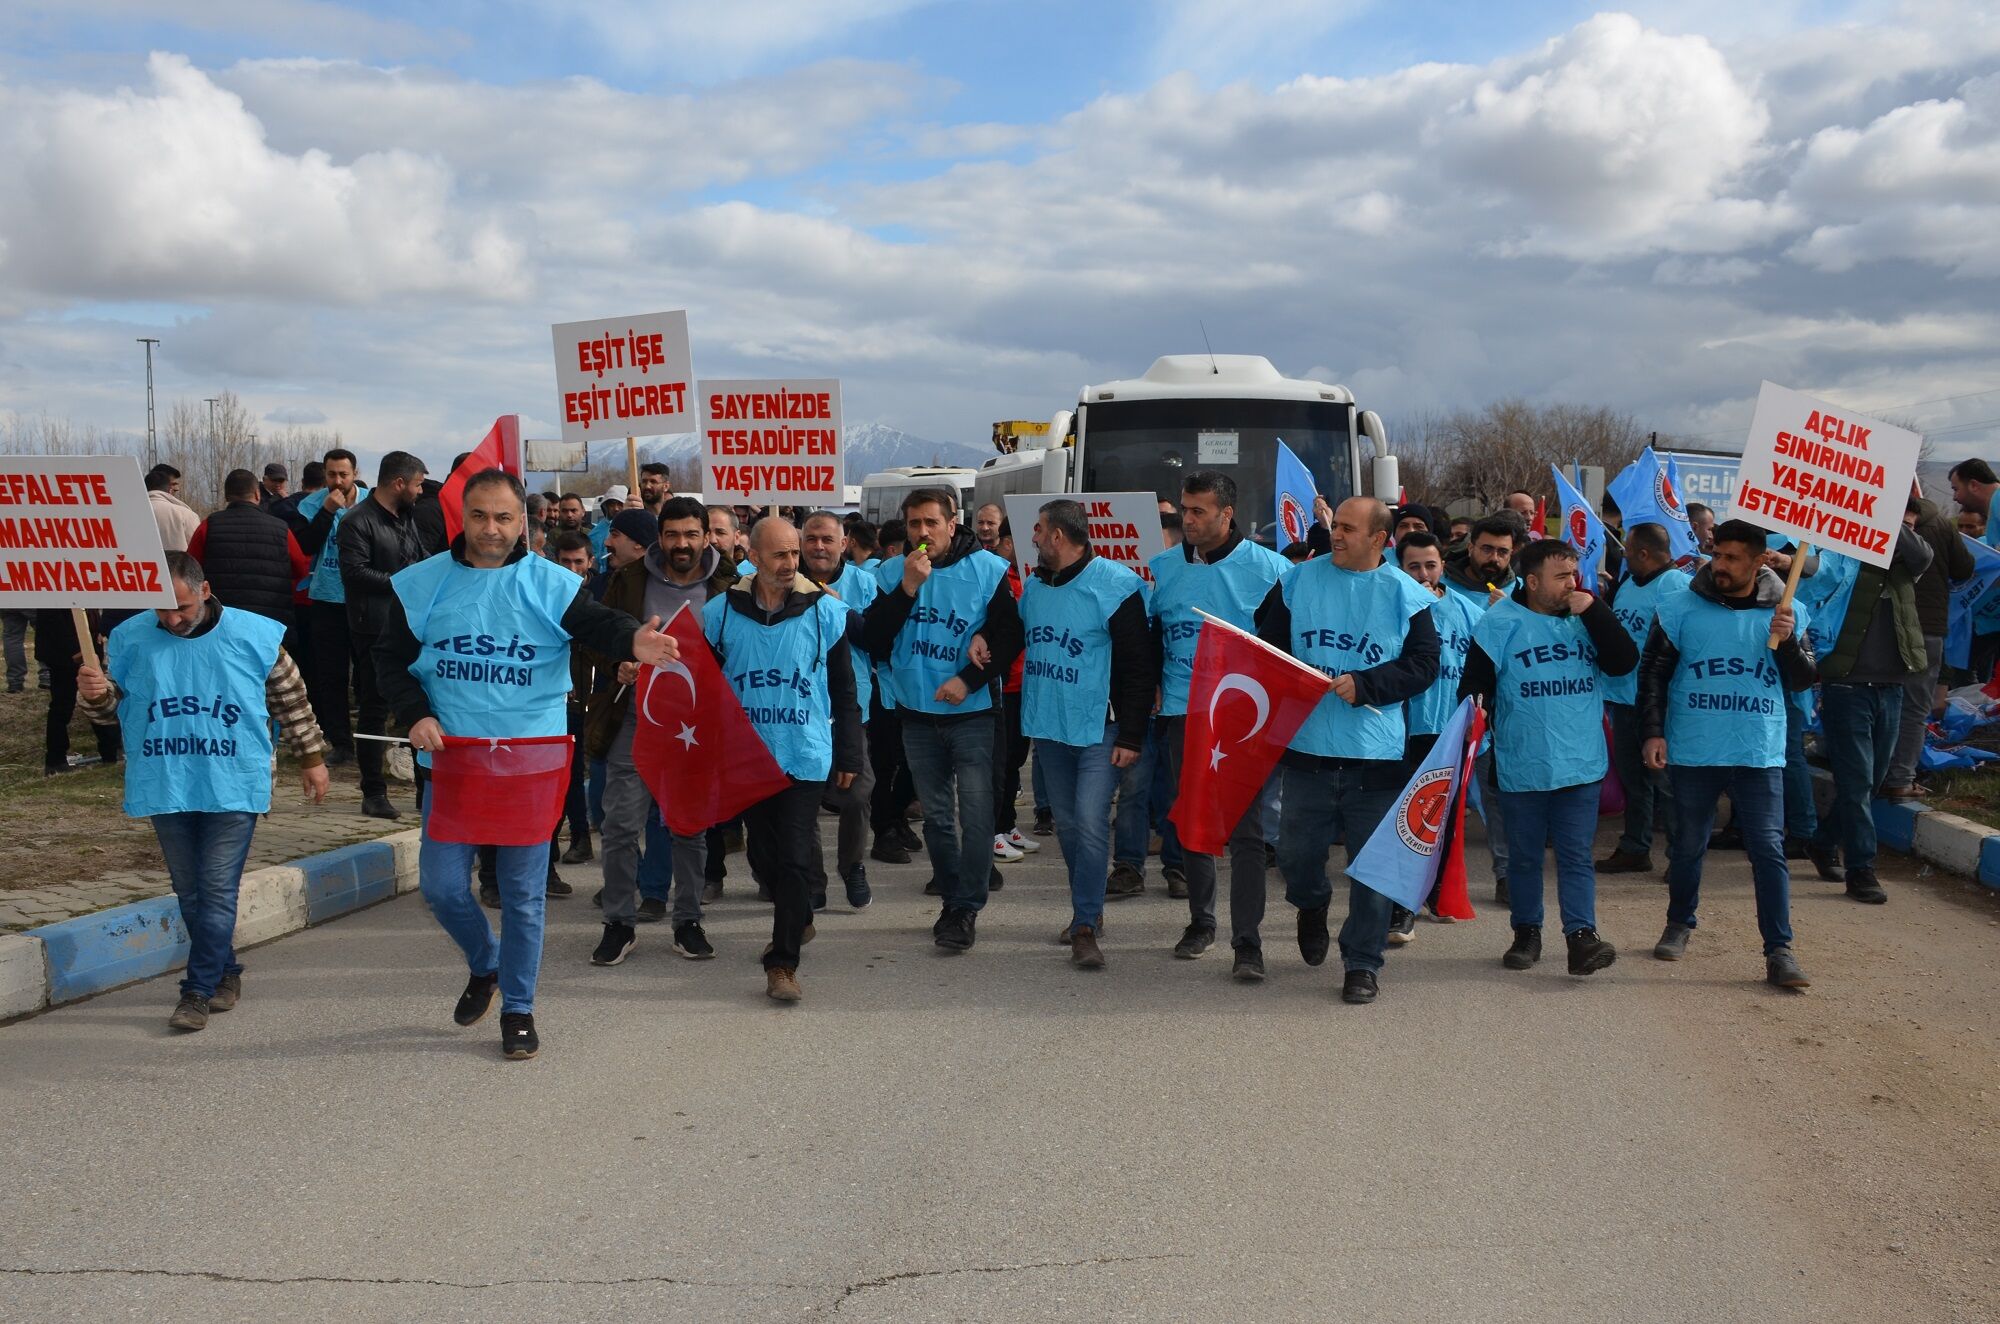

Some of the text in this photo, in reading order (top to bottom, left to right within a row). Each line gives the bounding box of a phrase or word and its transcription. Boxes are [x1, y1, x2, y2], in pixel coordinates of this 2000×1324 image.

[578, 329, 665, 378] EŞİT İŞE
[565, 382, 686, 429] EŞİT ÜCRET
[710, 387, 831, 420] SAYENİZDE
[707, 425, 836, 455] TESADÜFEN
[1804, 410, 1871, 451] AÇLIK
[1774, 431, 1884, 489] SINIRINDA
[0, 474, 112, 505] EFALETE
[712, 466, 834, 497] YAŞIYORUZ
[1772, 461, 1878, 518] YAŞAMAK
[1085, 502, 1113, 517] LIK
[1737, 480, 1890, 555] İSTEMİYORUZ
[0, 518, 118, 548] MAHKUM
[1094, 545, 1140, 560] MAK
[0, 555, 163, 592] LMAYACAĞIZ
[908, 606, 968, 637] ES-İŞ
[433, 634, 537, 662] TES-İŞ
[1025, 625, 1083, 658] TES-İŞ
[1300, 629, 1383, 664] TES-İŞ
[1515, 640, 1594, 668] TES-İŞ
[436, 658, 533, 687] SENDİKASI
[733, 667, 812, 698] TES-İŞ
[1025, 658, 1079, 684] SENDİKASI
[1688, 657, 1777, 689] TES-İŞ
[1520, 676, 1593, 698] SENDİKAS
[1688, 691, 1774, 715] SENDİKASI
[143, 733, 236, 757] SENDİKASI
